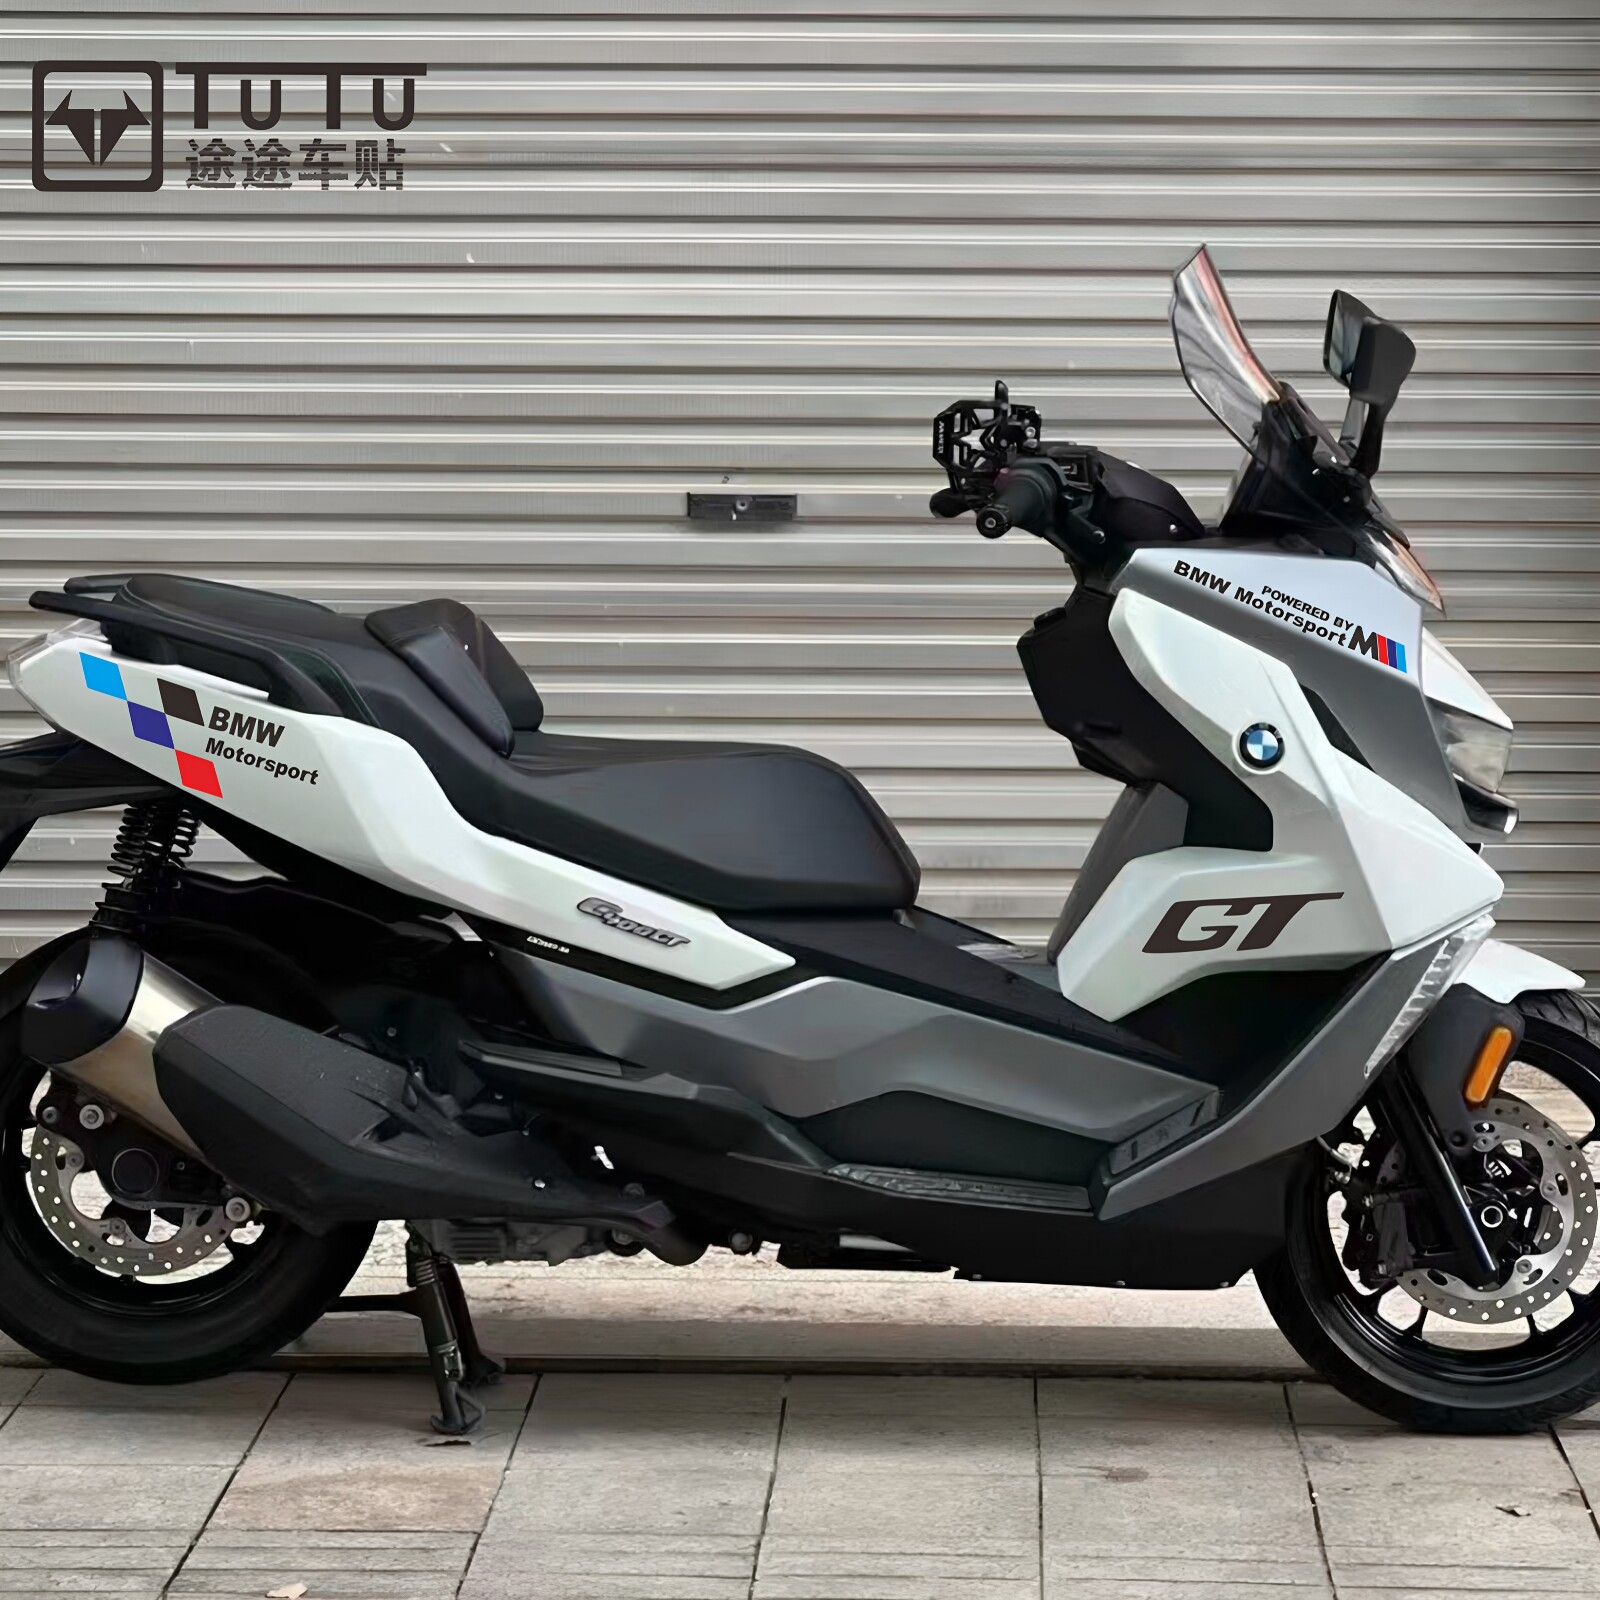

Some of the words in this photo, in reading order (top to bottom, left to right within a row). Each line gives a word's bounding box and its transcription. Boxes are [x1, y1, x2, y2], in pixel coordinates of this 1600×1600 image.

[1173, 559, 1232, 594] BMW
[1233, 586, 1348, 647] Motorsport
[1261, 585, 1330, 622] POWERED
[1333, 616, 1355, 632] BY
[208, 705, 286, 748] BMW
[204, 737, 319, 785] Motorsport
[1141, 891, 1345, 954] GT
